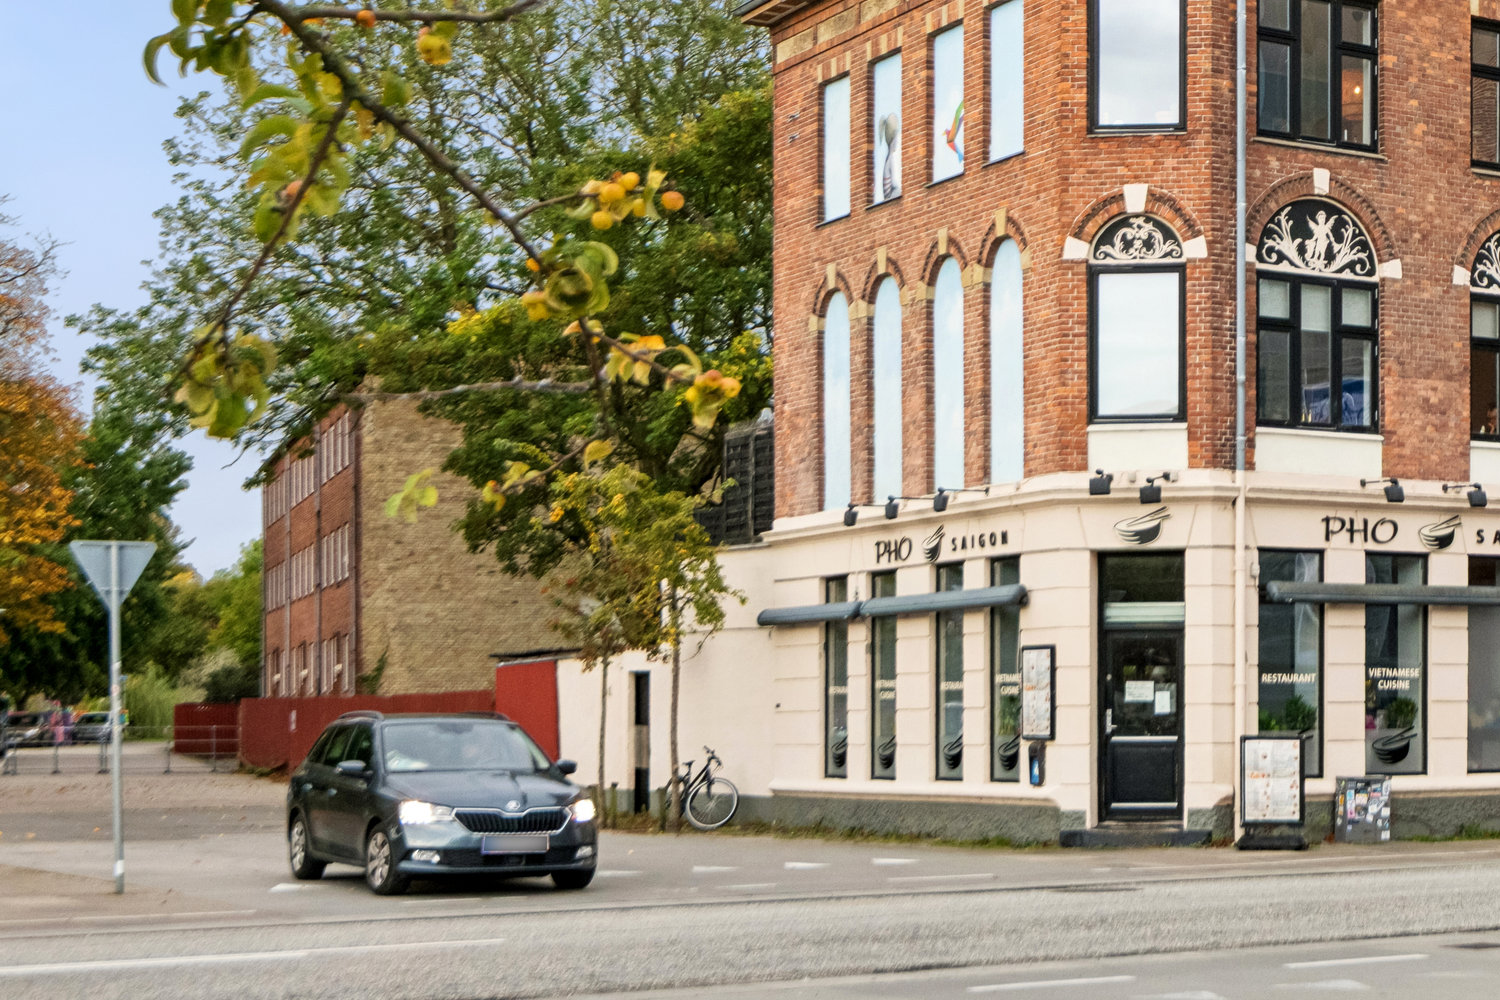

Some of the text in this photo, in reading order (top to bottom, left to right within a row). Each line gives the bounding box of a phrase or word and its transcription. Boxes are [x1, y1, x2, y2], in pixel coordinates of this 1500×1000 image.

[1321, 516, 1399, 544] PHO
[875, 530, 1008, 563] PHO SAIGON
[1368, 667, 1419, 678] VIETNAMESE
[1261, 673, 1316, 684] RESTAURANT
[1378, 680, 1410, 690] CUISINE
